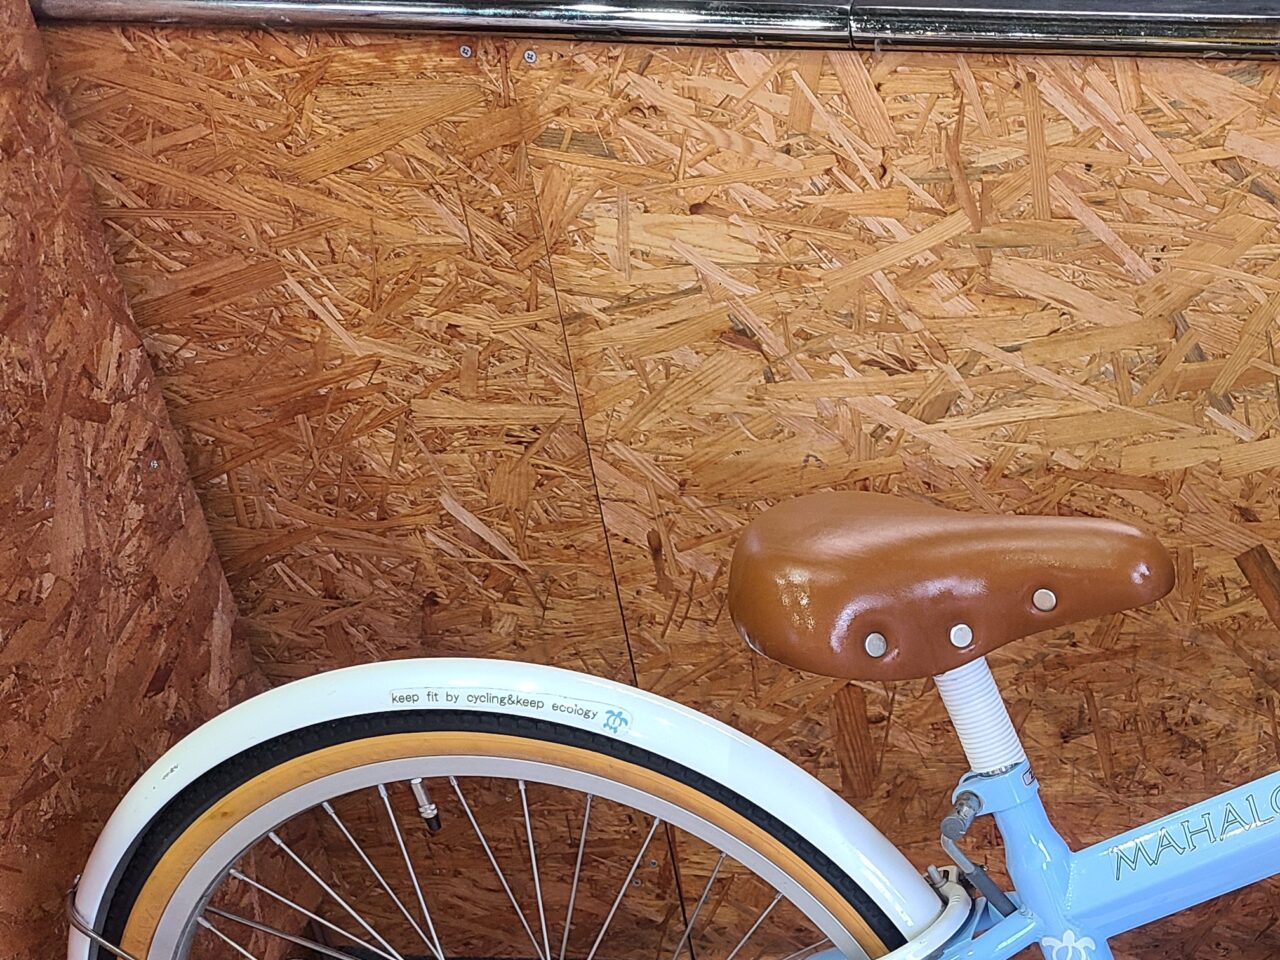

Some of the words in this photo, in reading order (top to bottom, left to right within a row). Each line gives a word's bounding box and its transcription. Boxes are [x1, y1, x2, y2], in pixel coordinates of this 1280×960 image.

[391, 692, 419, 705] keep
[426, 691, 439, 702] fit
[445, 691, 460, 704] by
[466, 692, 545, 710] cycling&keep
[551, 703, 599, 720] ecology
